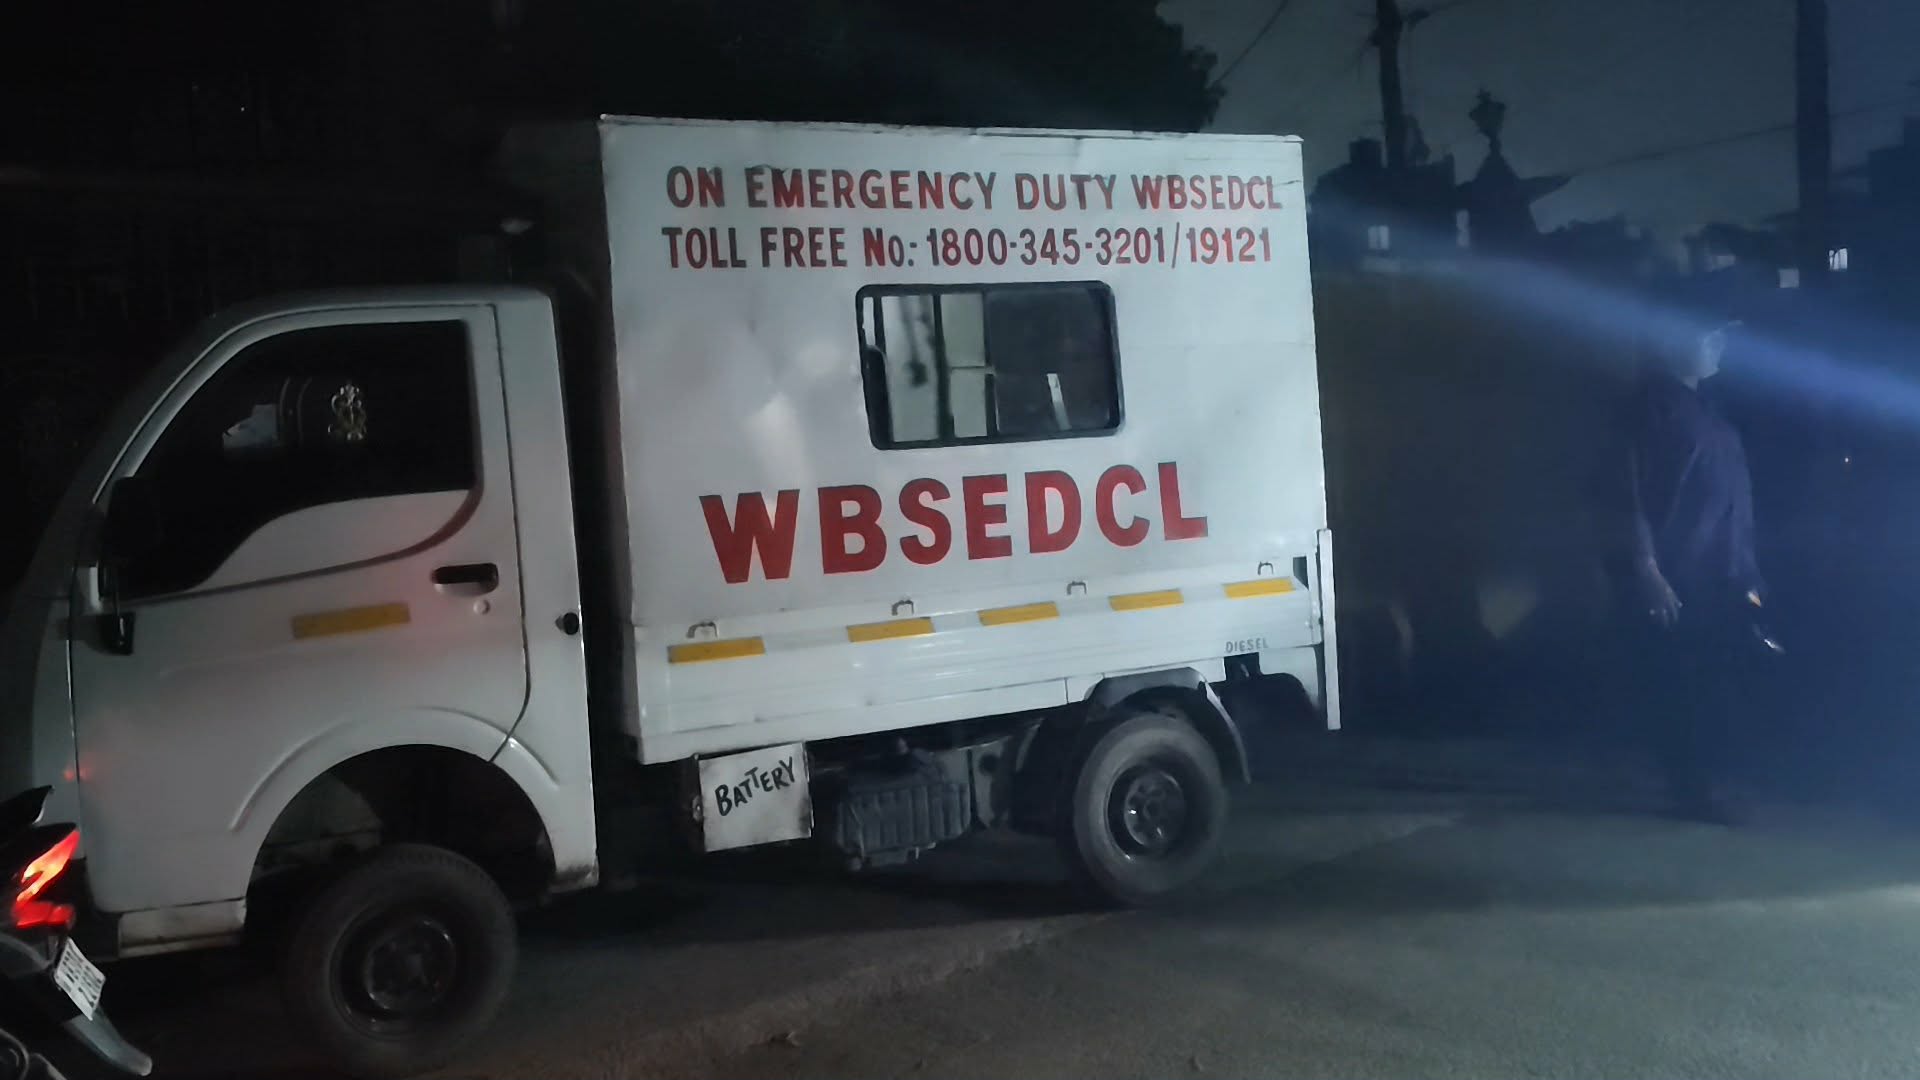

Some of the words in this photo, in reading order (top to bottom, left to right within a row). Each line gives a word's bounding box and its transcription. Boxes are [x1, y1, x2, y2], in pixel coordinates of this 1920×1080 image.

[667, 166, 725, 208] ON
[745, 166, 996, 210] EMERGENCY
[1015, 173, 1116, 211] DUTY
[1131, 174, 1282, 210] WBSEDCL
[662, 227, 747, 269] TOLL
[760, 227, 847, 268] FREE
[699, 461, 1208, 584] WBSEDCL
[1226, 637, 1269, 653] DIESEL
[715, 756, 795, 816] BATTERY
